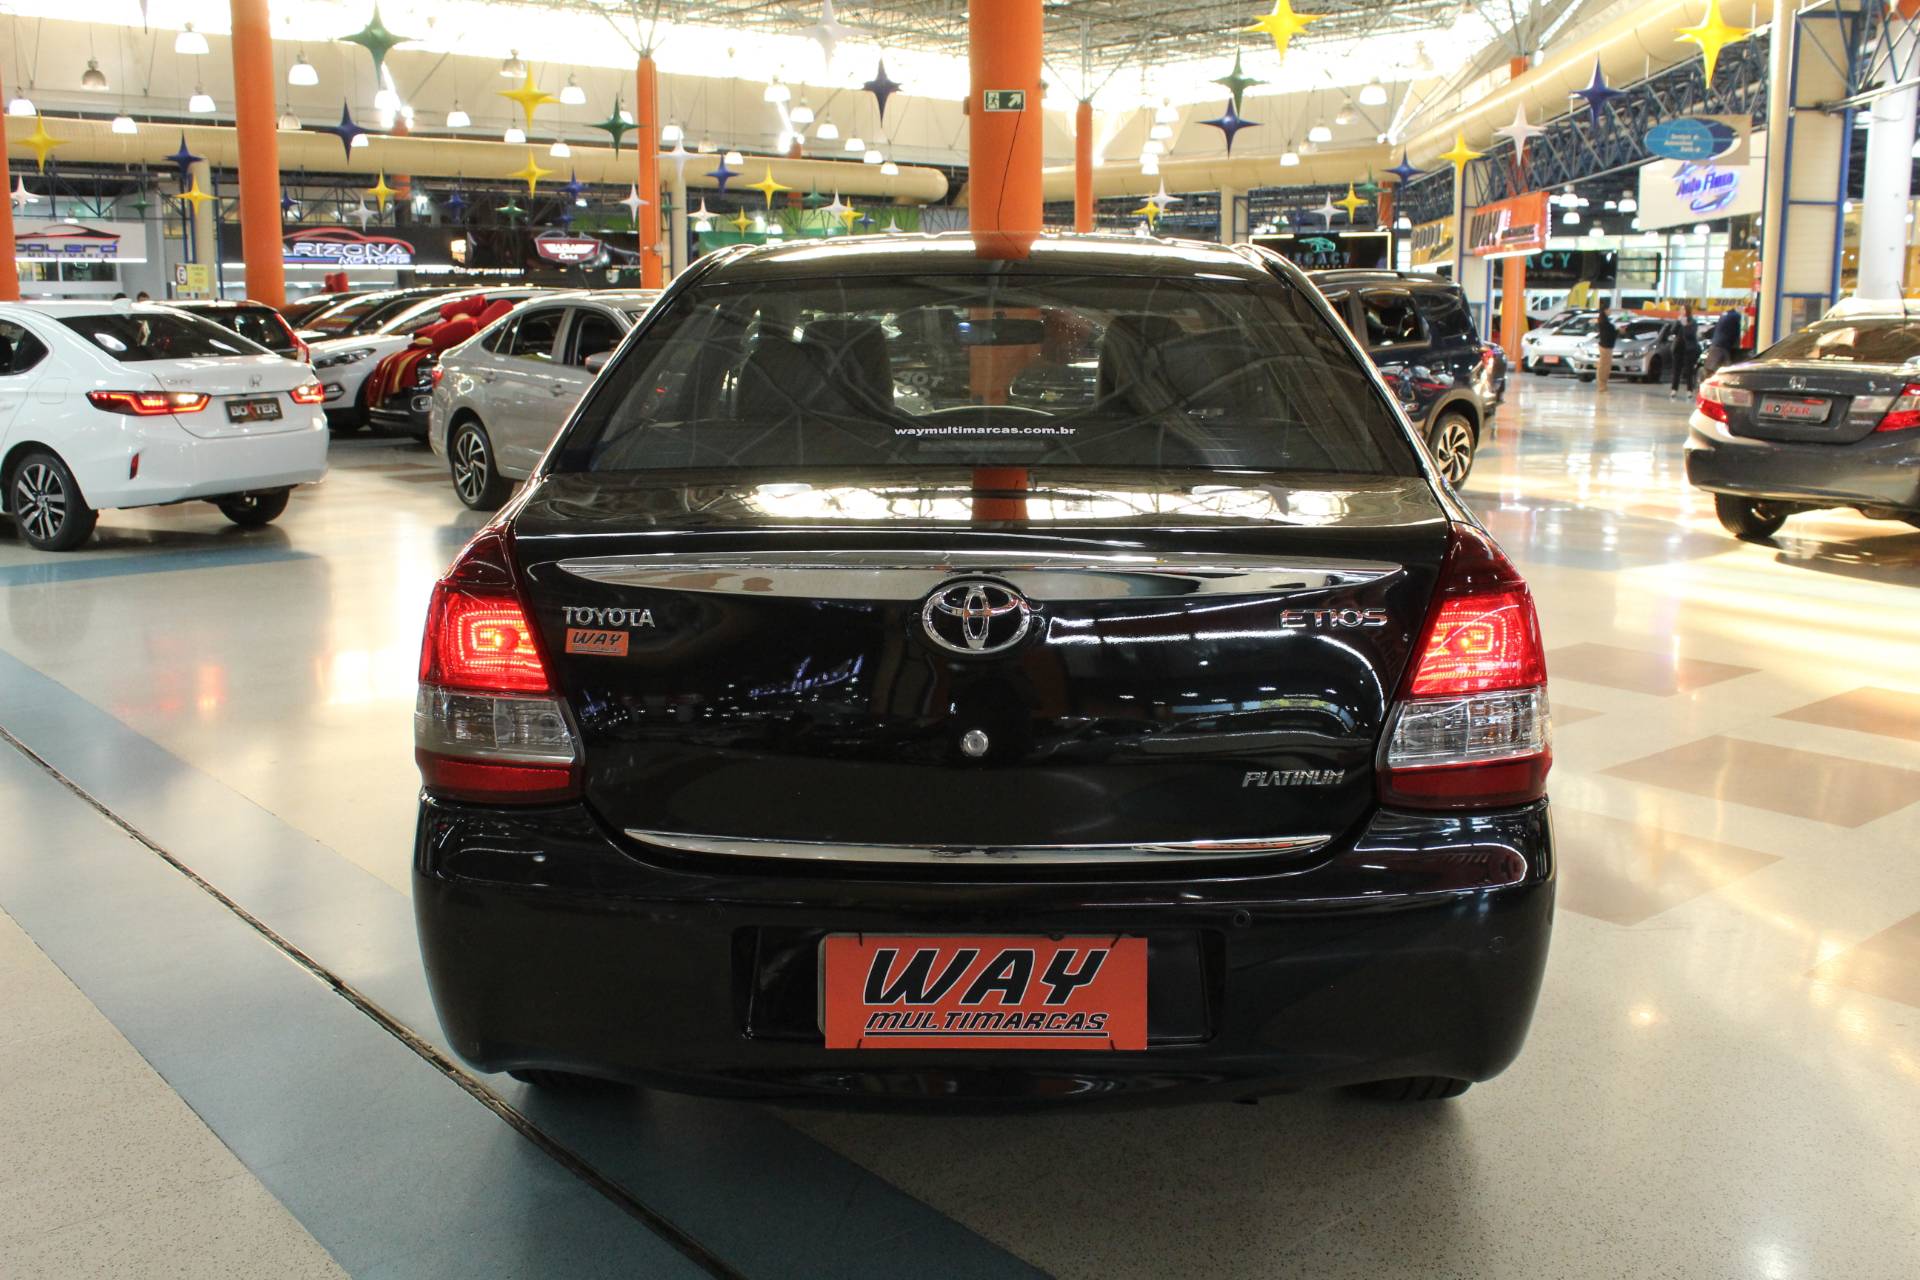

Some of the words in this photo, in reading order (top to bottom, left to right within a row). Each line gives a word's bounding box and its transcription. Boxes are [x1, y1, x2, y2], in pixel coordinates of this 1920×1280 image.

[894, 426, 1076, 437] waymultimarcas.com.br
[562, 606, 656, 628] TOYOTA
[1280, 608, 1388, 627] ETIOS
[573, 631, 622, 645] WAY
[1242, 769, 1345, 787] PLATINUM
[863, 948, 1110, 1006] WAY
[864, 1011, 1109, 1031] MULTIMARCAS
